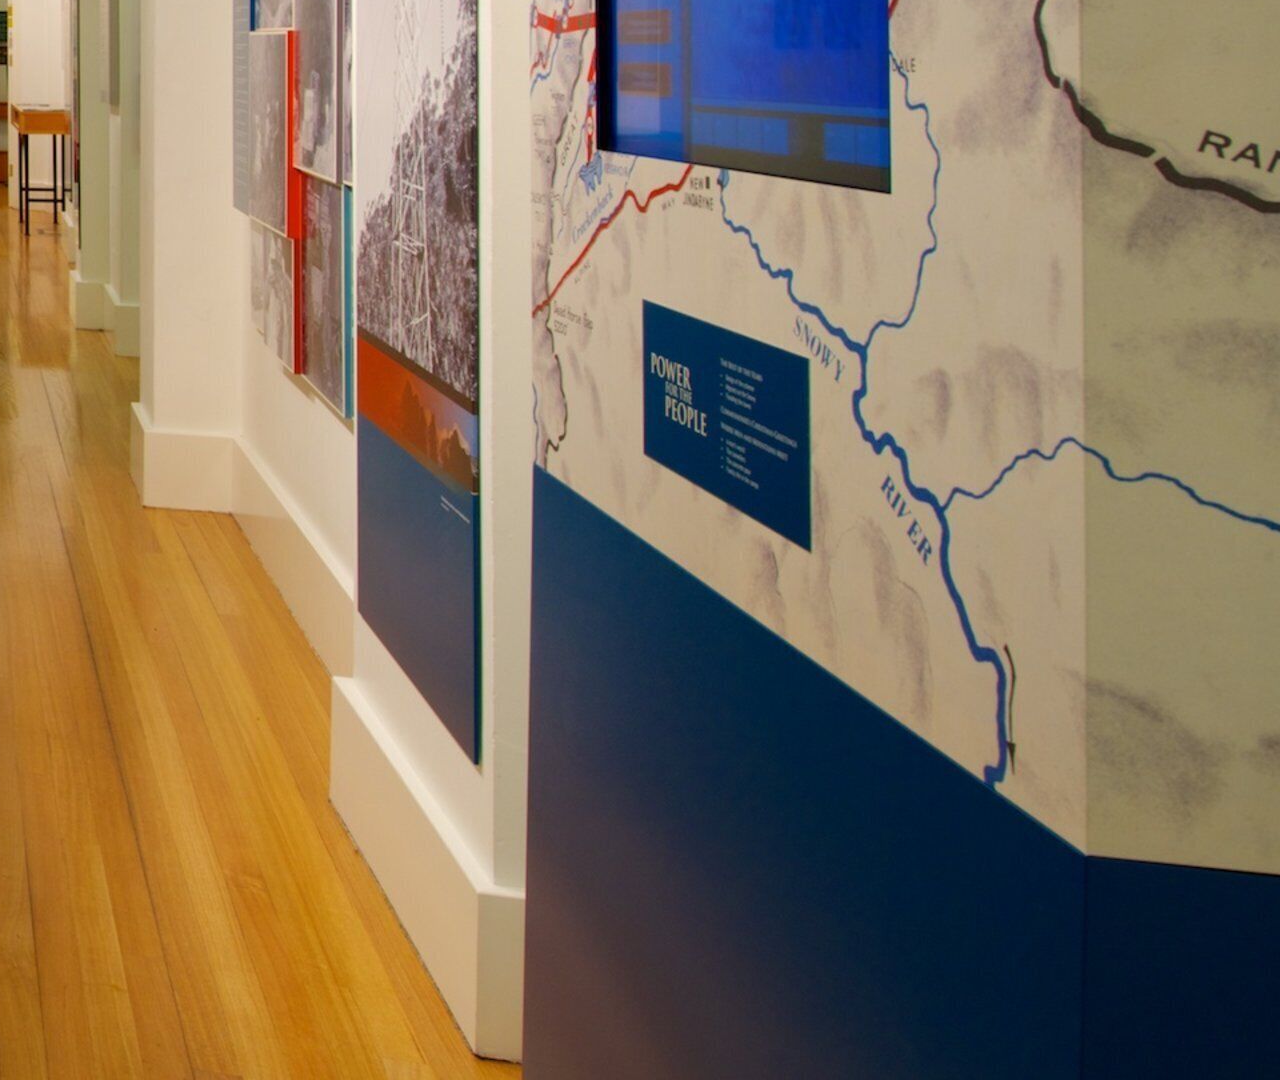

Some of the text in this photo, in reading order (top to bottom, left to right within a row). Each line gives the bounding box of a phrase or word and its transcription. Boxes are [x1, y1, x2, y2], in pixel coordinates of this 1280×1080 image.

[650, 351, 693, 391] POWER
[793, 316, 846, 384] SNOWY
[664, 395, 708, 438] PEOPLE
[880, 475, 933, 566] RIVER
